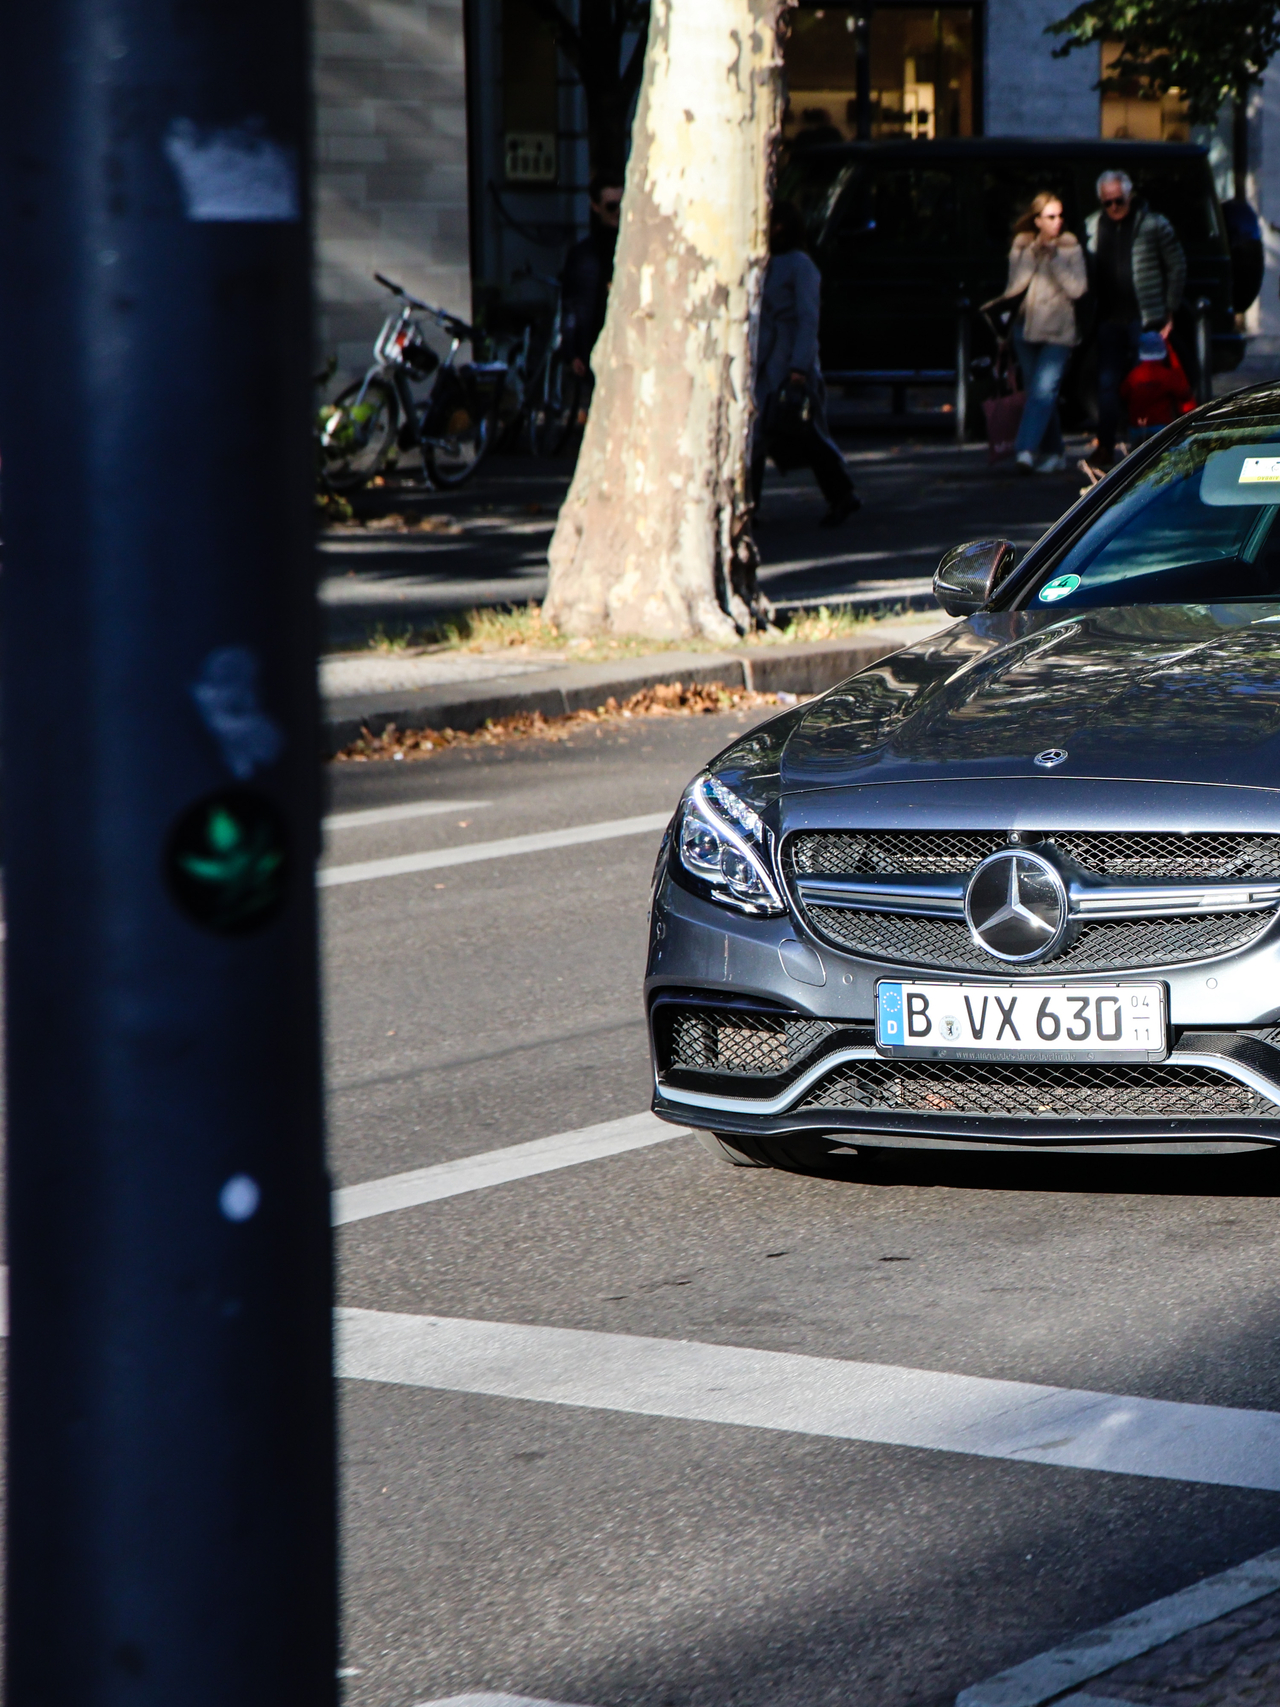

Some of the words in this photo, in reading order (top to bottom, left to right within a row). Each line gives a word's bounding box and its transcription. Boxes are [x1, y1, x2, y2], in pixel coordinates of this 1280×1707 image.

[1130, 995, 1150, 1008] 04
[906, 993, 932, 1038] B
[964, 995, 1021, 1042] VX
[1036, 996, 1123, 1042] 630
[887, 1020, 898, 1035] D
[1134, 1028, 1150, 1042] 11
